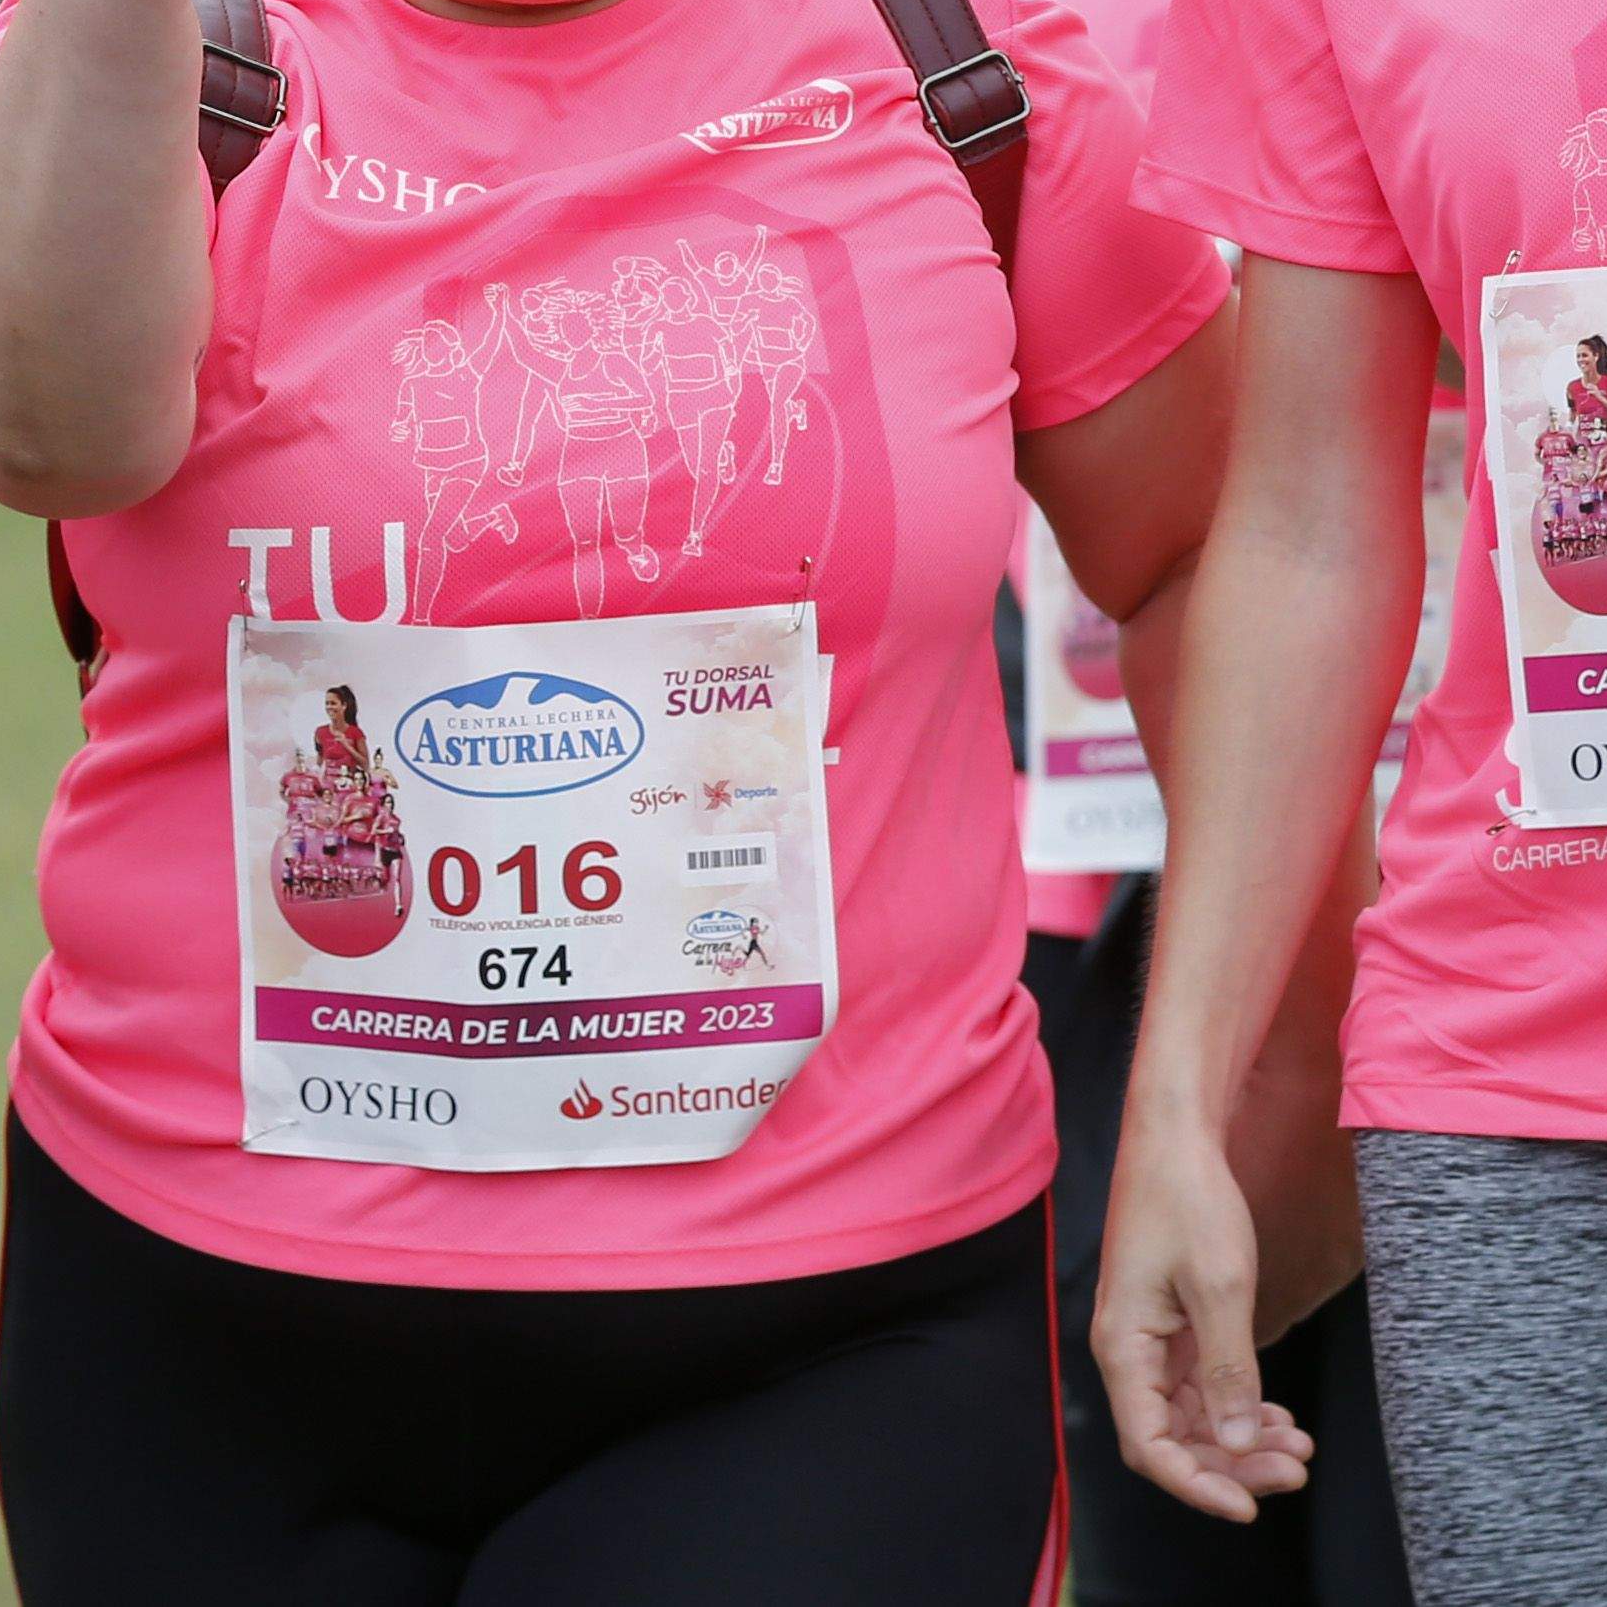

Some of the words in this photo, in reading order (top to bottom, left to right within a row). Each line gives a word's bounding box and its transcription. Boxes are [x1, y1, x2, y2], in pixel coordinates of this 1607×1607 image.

[227, 521, 408, 624] TU
[663, 670, 690, 687] TU
[694, 664, 775, 684] DORSAL
[664, 683, 774, 717] SUMA
[446, 715, 529, 730] CENTRAL
[536, 708, 617, 725] LECHERA
[412, 717, 628, 767] ASTURIANA
[629, 784, 688, 815] gijón
[734, 787, 778, 801] Deporte
[427, 840, 623, 917] 016
[428, 916, 486, 932] TELÉFONO
[489, 917, 553, 931] VIOLENCIA
[555, 917, 571, 928] DE
[573, 913, 624, 927] GÉNERO
[682, 940, 732, 955] Carrera
[478, 944, 572, 990] 674
[310, 1005, 454, 1044] CARRERA
[460, 1017, 508, 1045] DE
[515, 1016, 561, 1044] LA
[567, 1008, 686, 1042] MUJER
[698, 1002, 775, 1032] 2023
[300, 1076, 458, 1126] OYSHO
[610, 1077, 789, 1118] Santander
